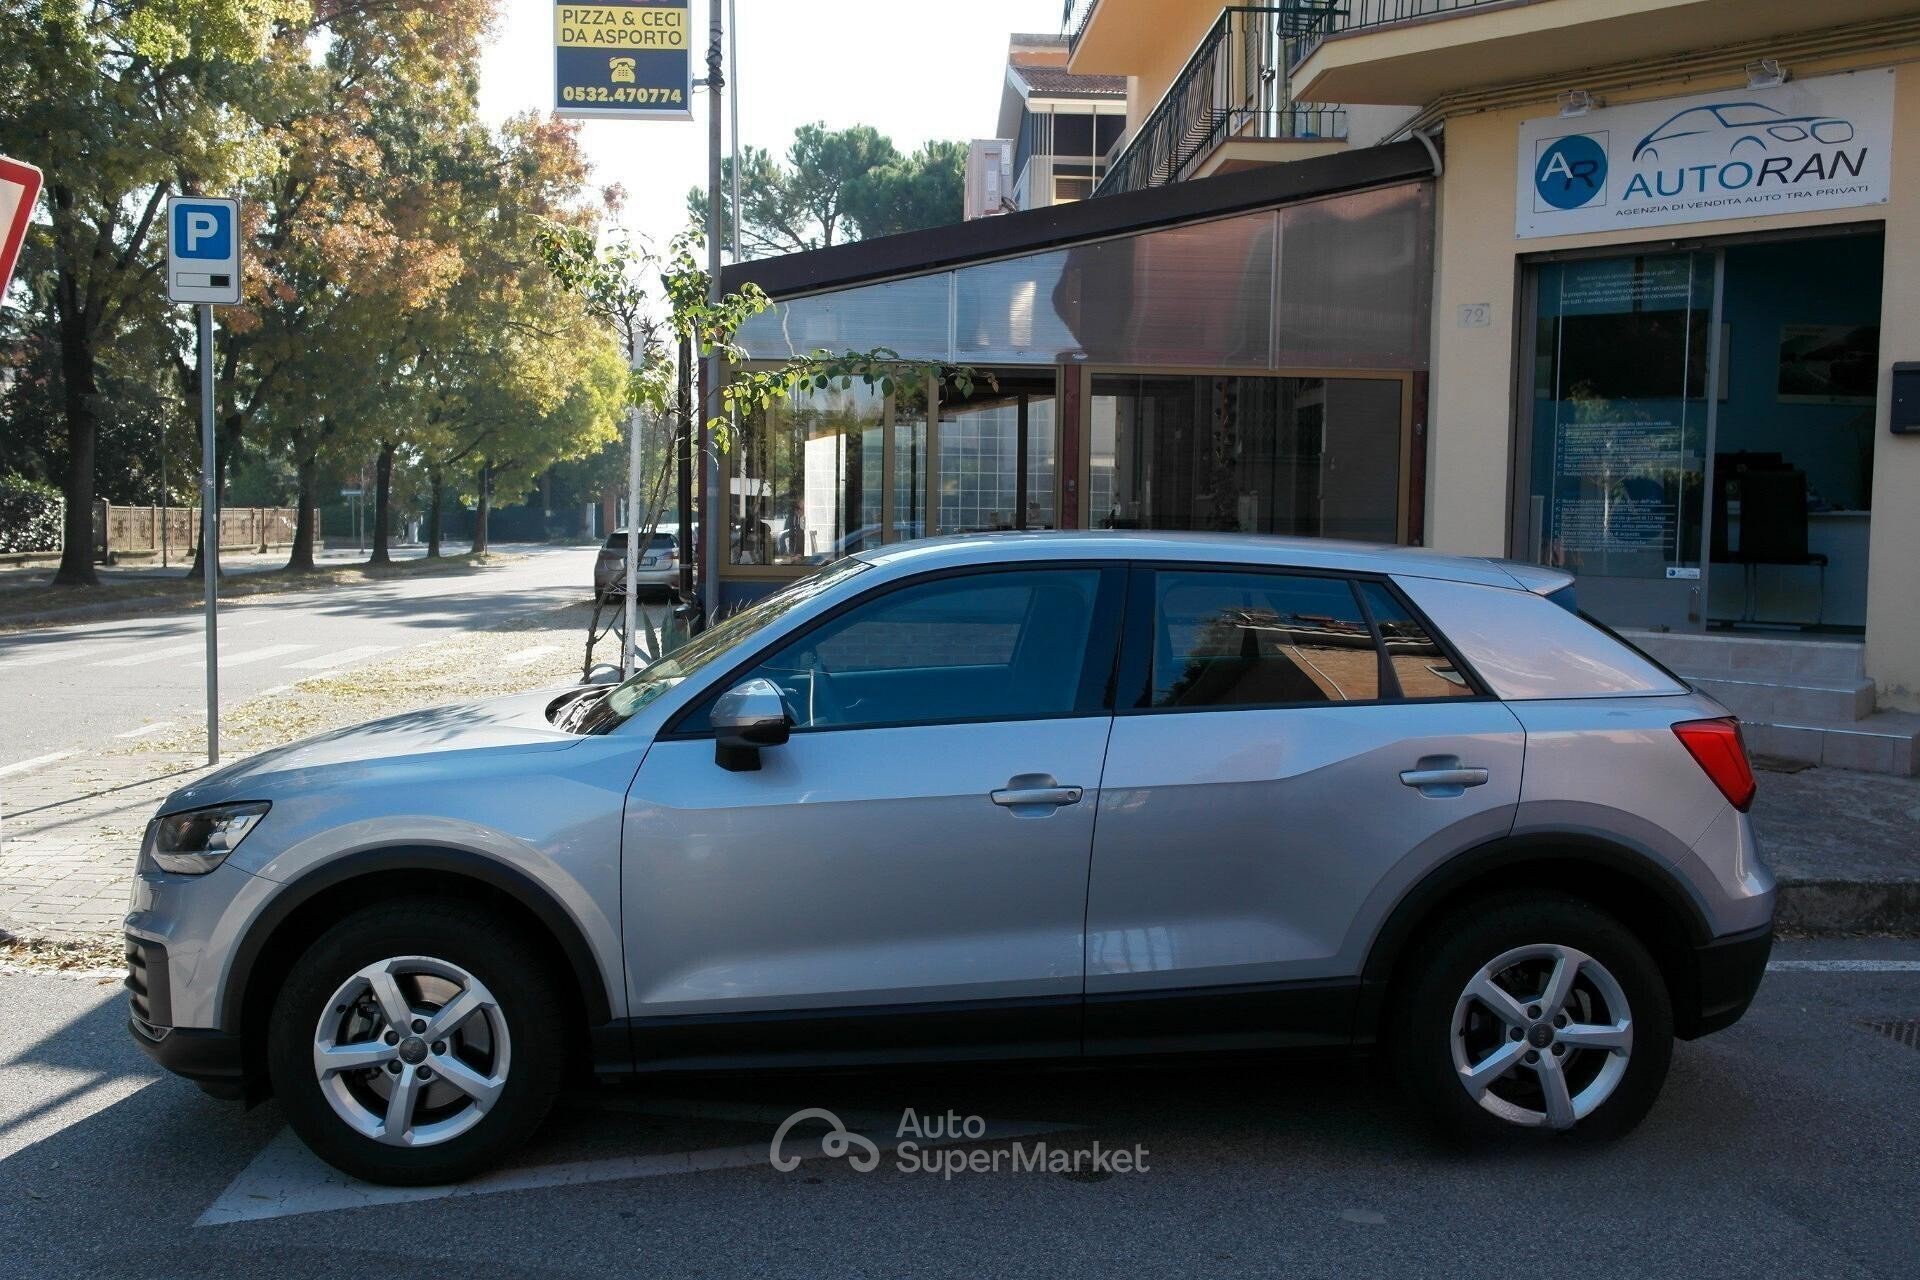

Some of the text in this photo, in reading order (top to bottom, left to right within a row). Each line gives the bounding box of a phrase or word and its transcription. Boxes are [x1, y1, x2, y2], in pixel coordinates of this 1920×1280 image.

[562, 9, 681, 27] PIZZA & CECI
[562, 28, 682, 45] DA ASPORTO
[563, 86, 682, 104] 0532.470774
[1622, 148, 1868, 201] AUTORAN
[1615, 185, 1868, 217] AGENZIA DI VENDITA AUTO TRA PRIVATI
[187, 213, 219, 251] P
[1463, 308, 1484, 322] 72
